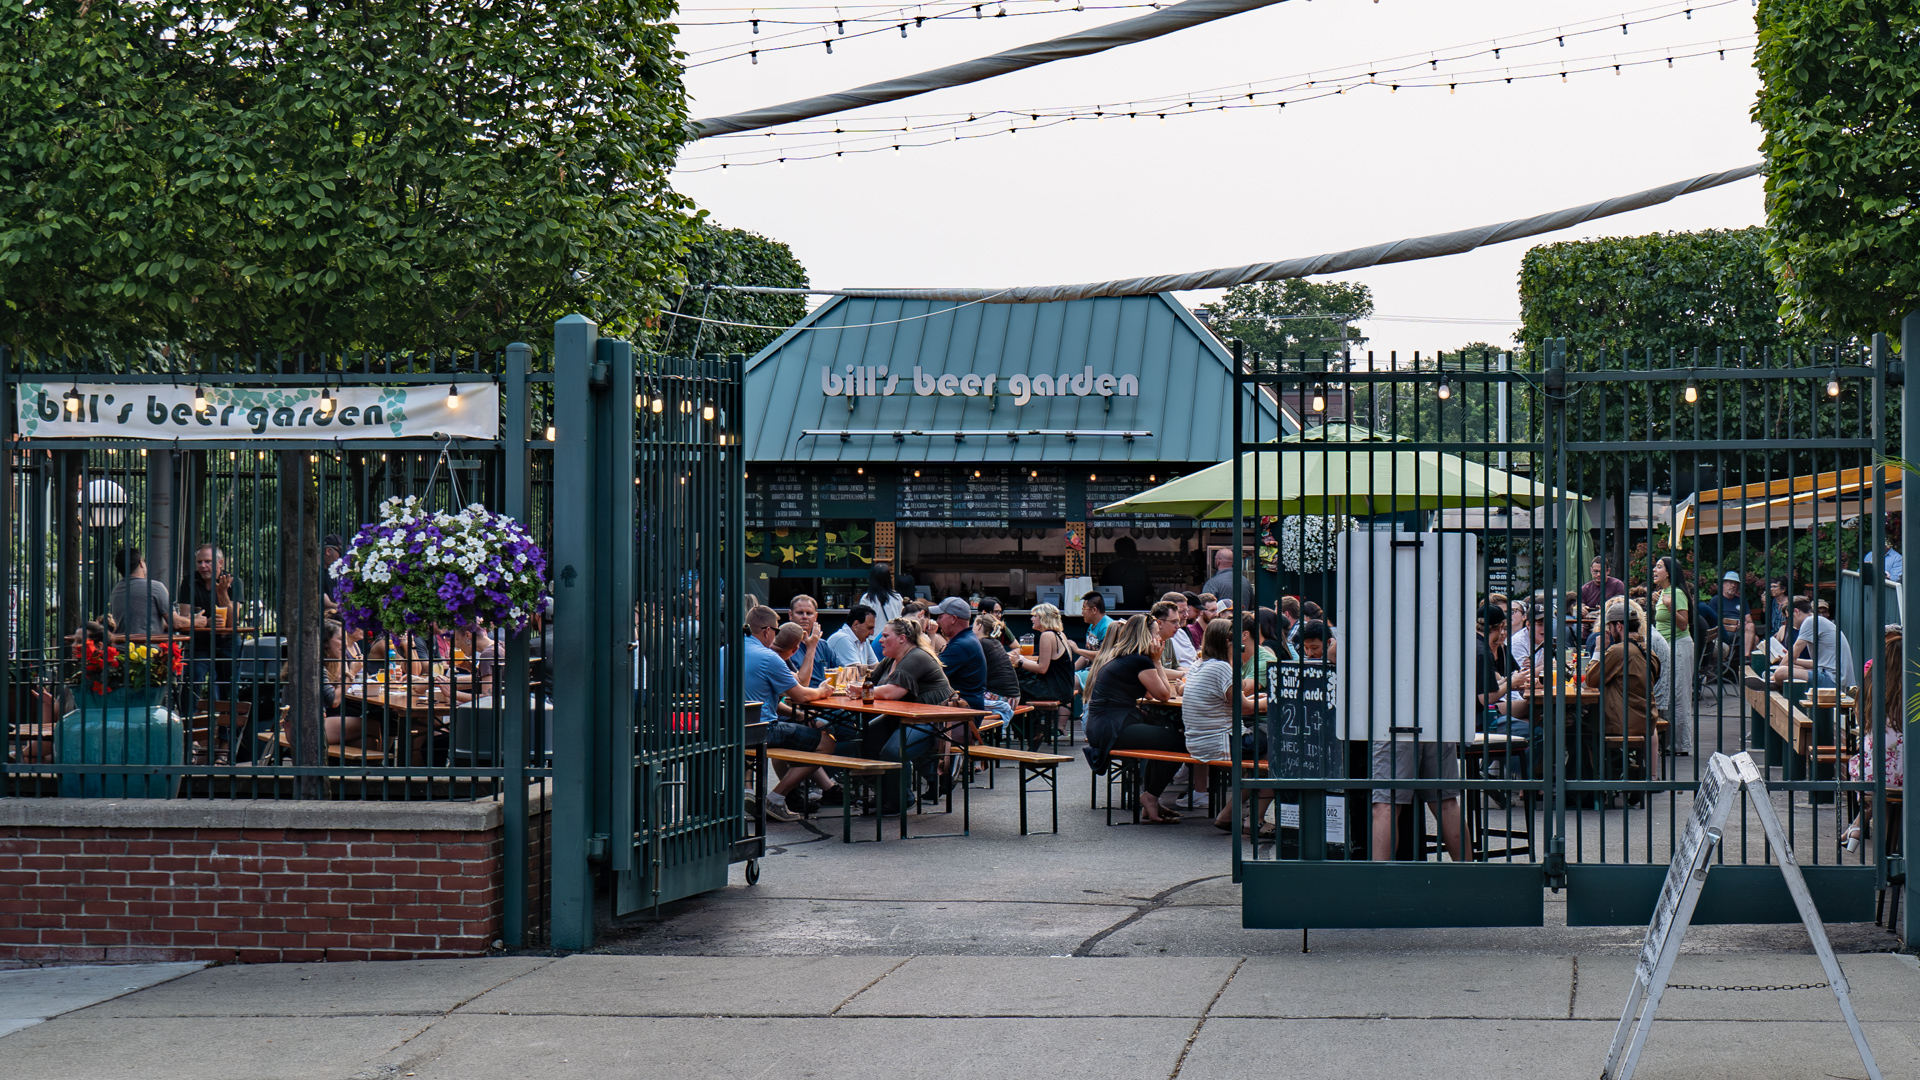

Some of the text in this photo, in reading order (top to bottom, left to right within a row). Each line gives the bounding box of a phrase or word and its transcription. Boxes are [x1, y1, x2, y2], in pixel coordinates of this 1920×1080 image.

[821, 364, 1139, 406] bill's beer garden
[36, 391, 385, 435] bill's beer garden
